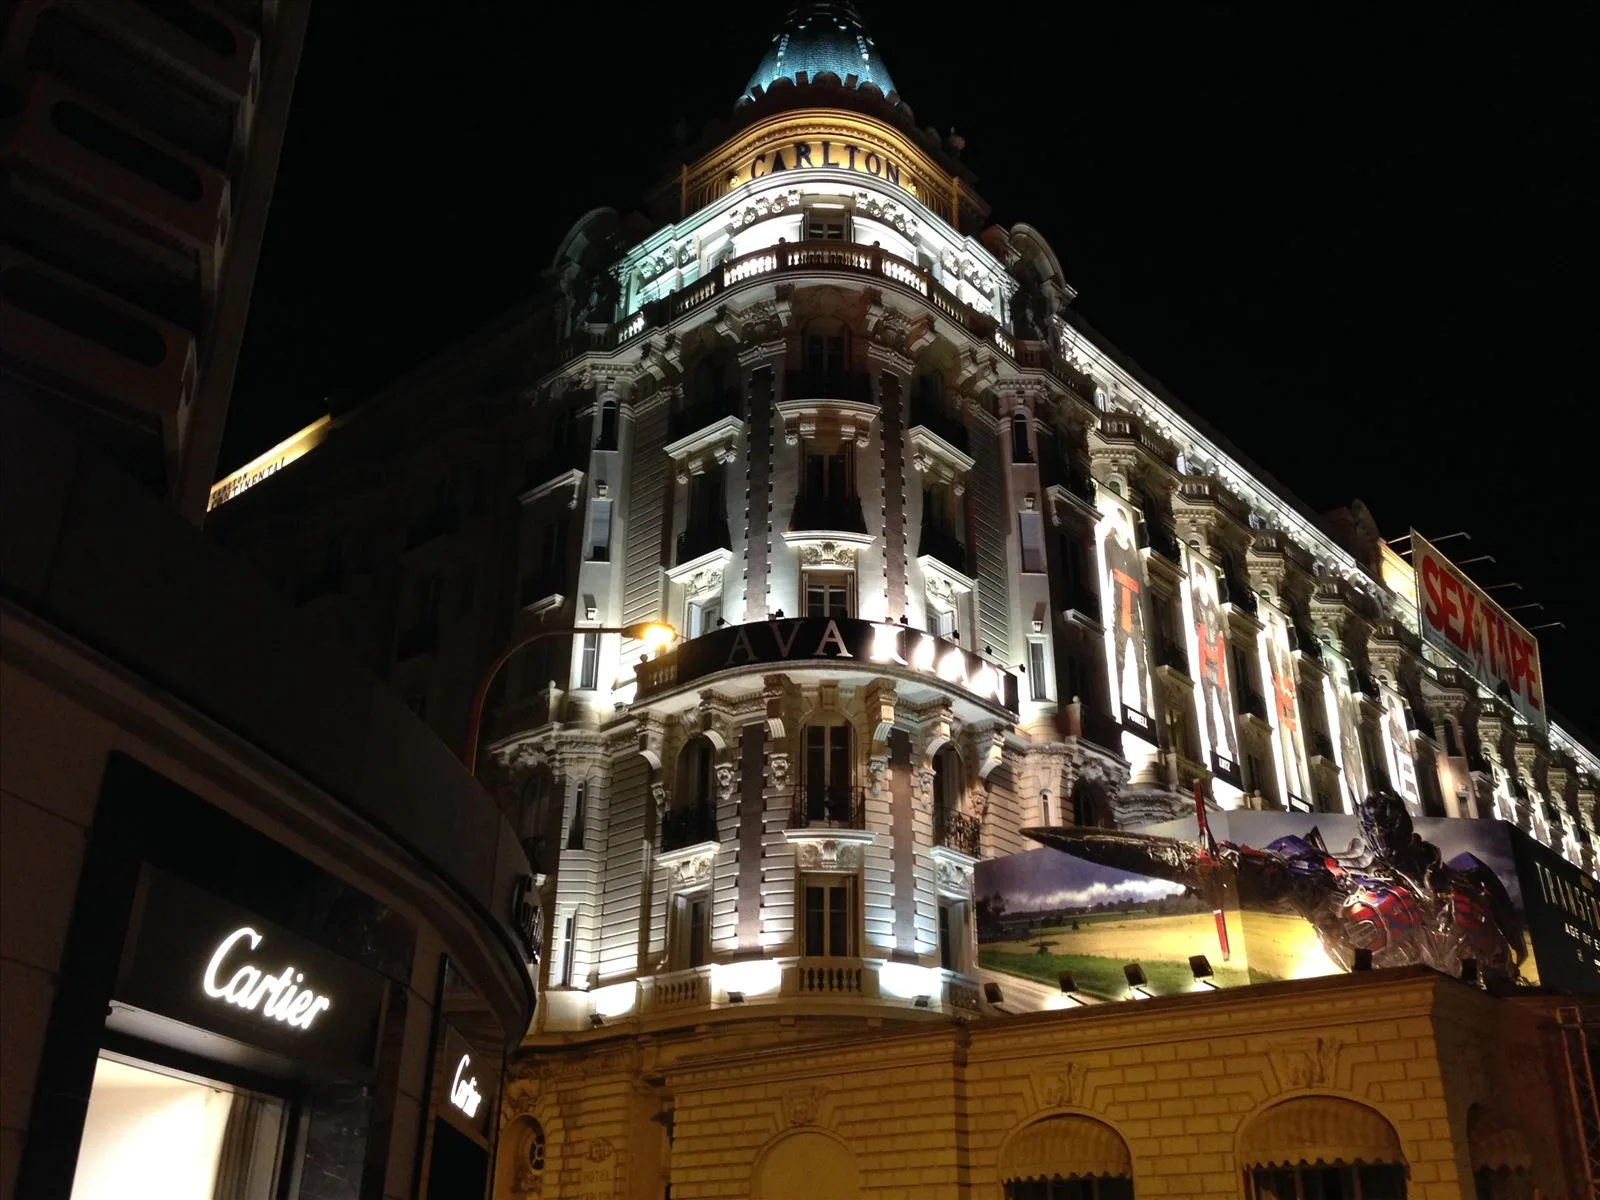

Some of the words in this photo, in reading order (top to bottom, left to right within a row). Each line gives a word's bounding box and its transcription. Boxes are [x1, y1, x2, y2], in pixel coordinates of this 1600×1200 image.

[750, 141, 901, 186] CARLTON
[1422, 555, 1482, 660] SEX
[1482, 604, 1541, 711] TAPE
[203, 926, 331, 1030] Cartier
